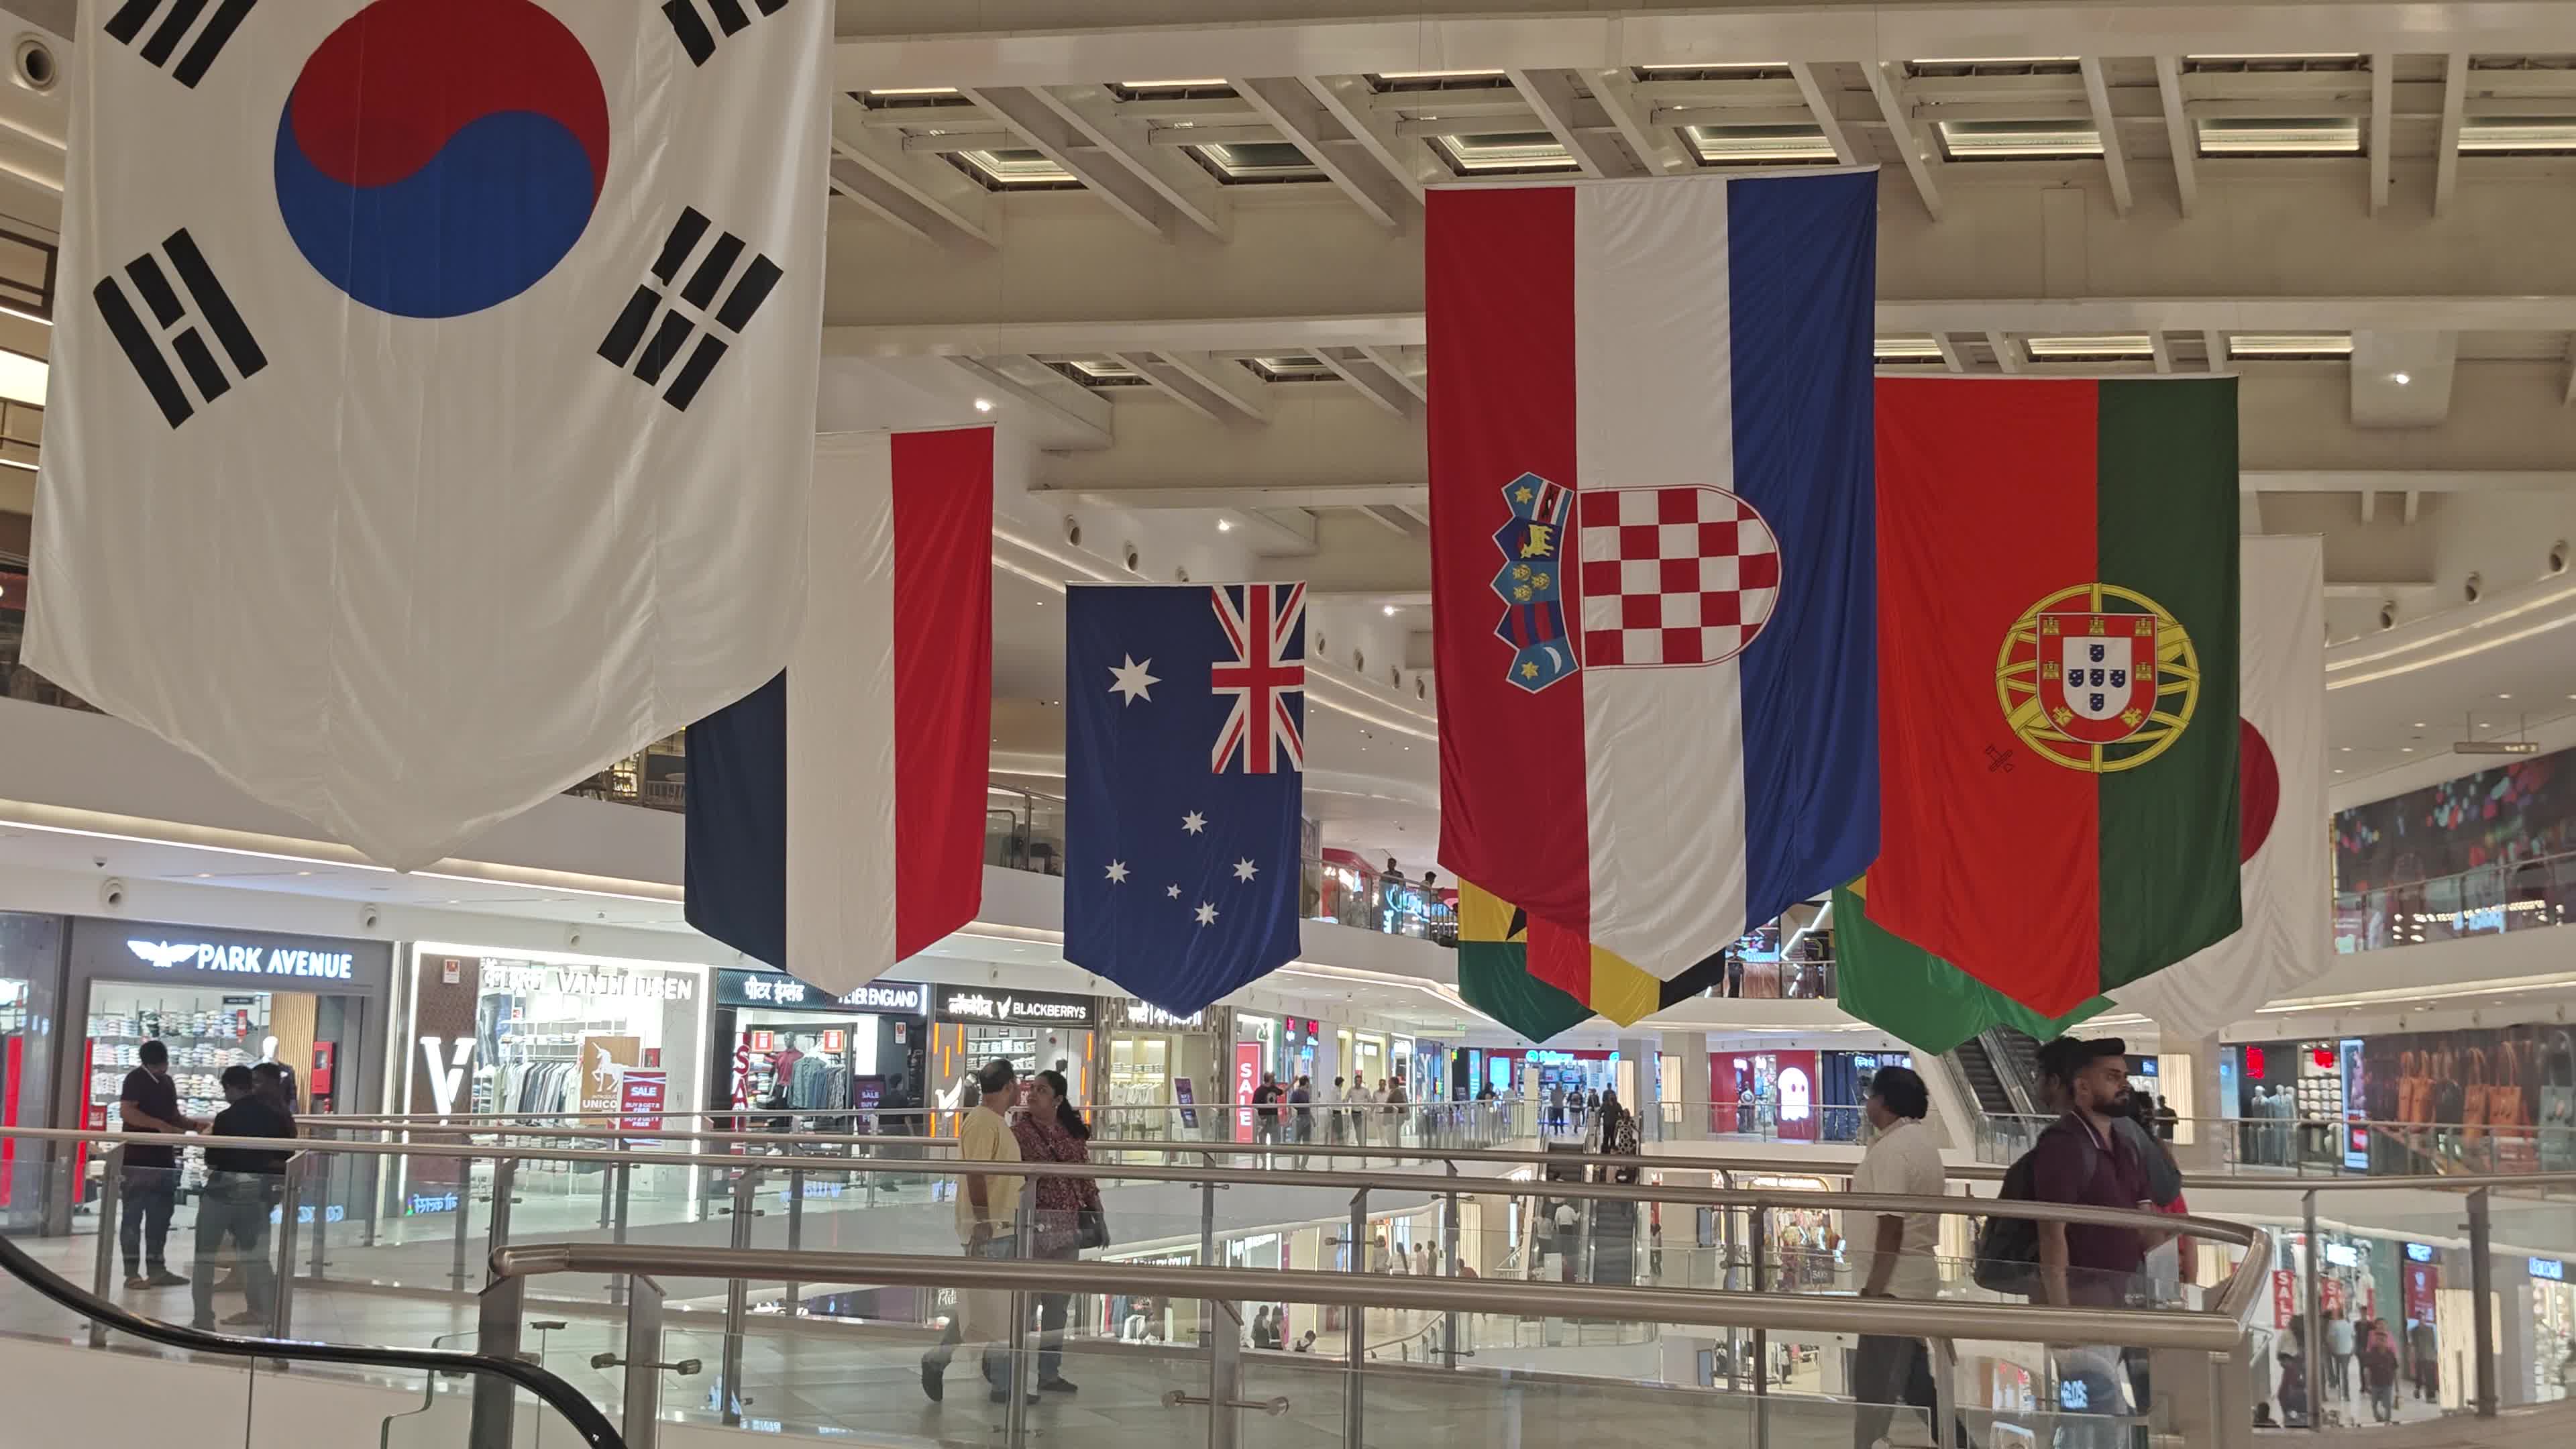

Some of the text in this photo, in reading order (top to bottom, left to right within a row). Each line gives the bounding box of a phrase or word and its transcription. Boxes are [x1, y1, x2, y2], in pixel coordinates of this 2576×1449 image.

[197, 943, 353, 979] PARK AVENUE
[557, 971, 602, 994] VAN
[744, 975, 772, 1000] पीटर
[839, 987, 918, 1007] ETER ENGLAND
[1013, 1002, 1087, 1020] BLACKBERRYS
[631, 1086, 657, 1097] SALE
[861, 1091, 879, 1099] SALE
[1238, 1063, 1254, 1126] SALE
[582, 1099, 618, 1109] UNICO
